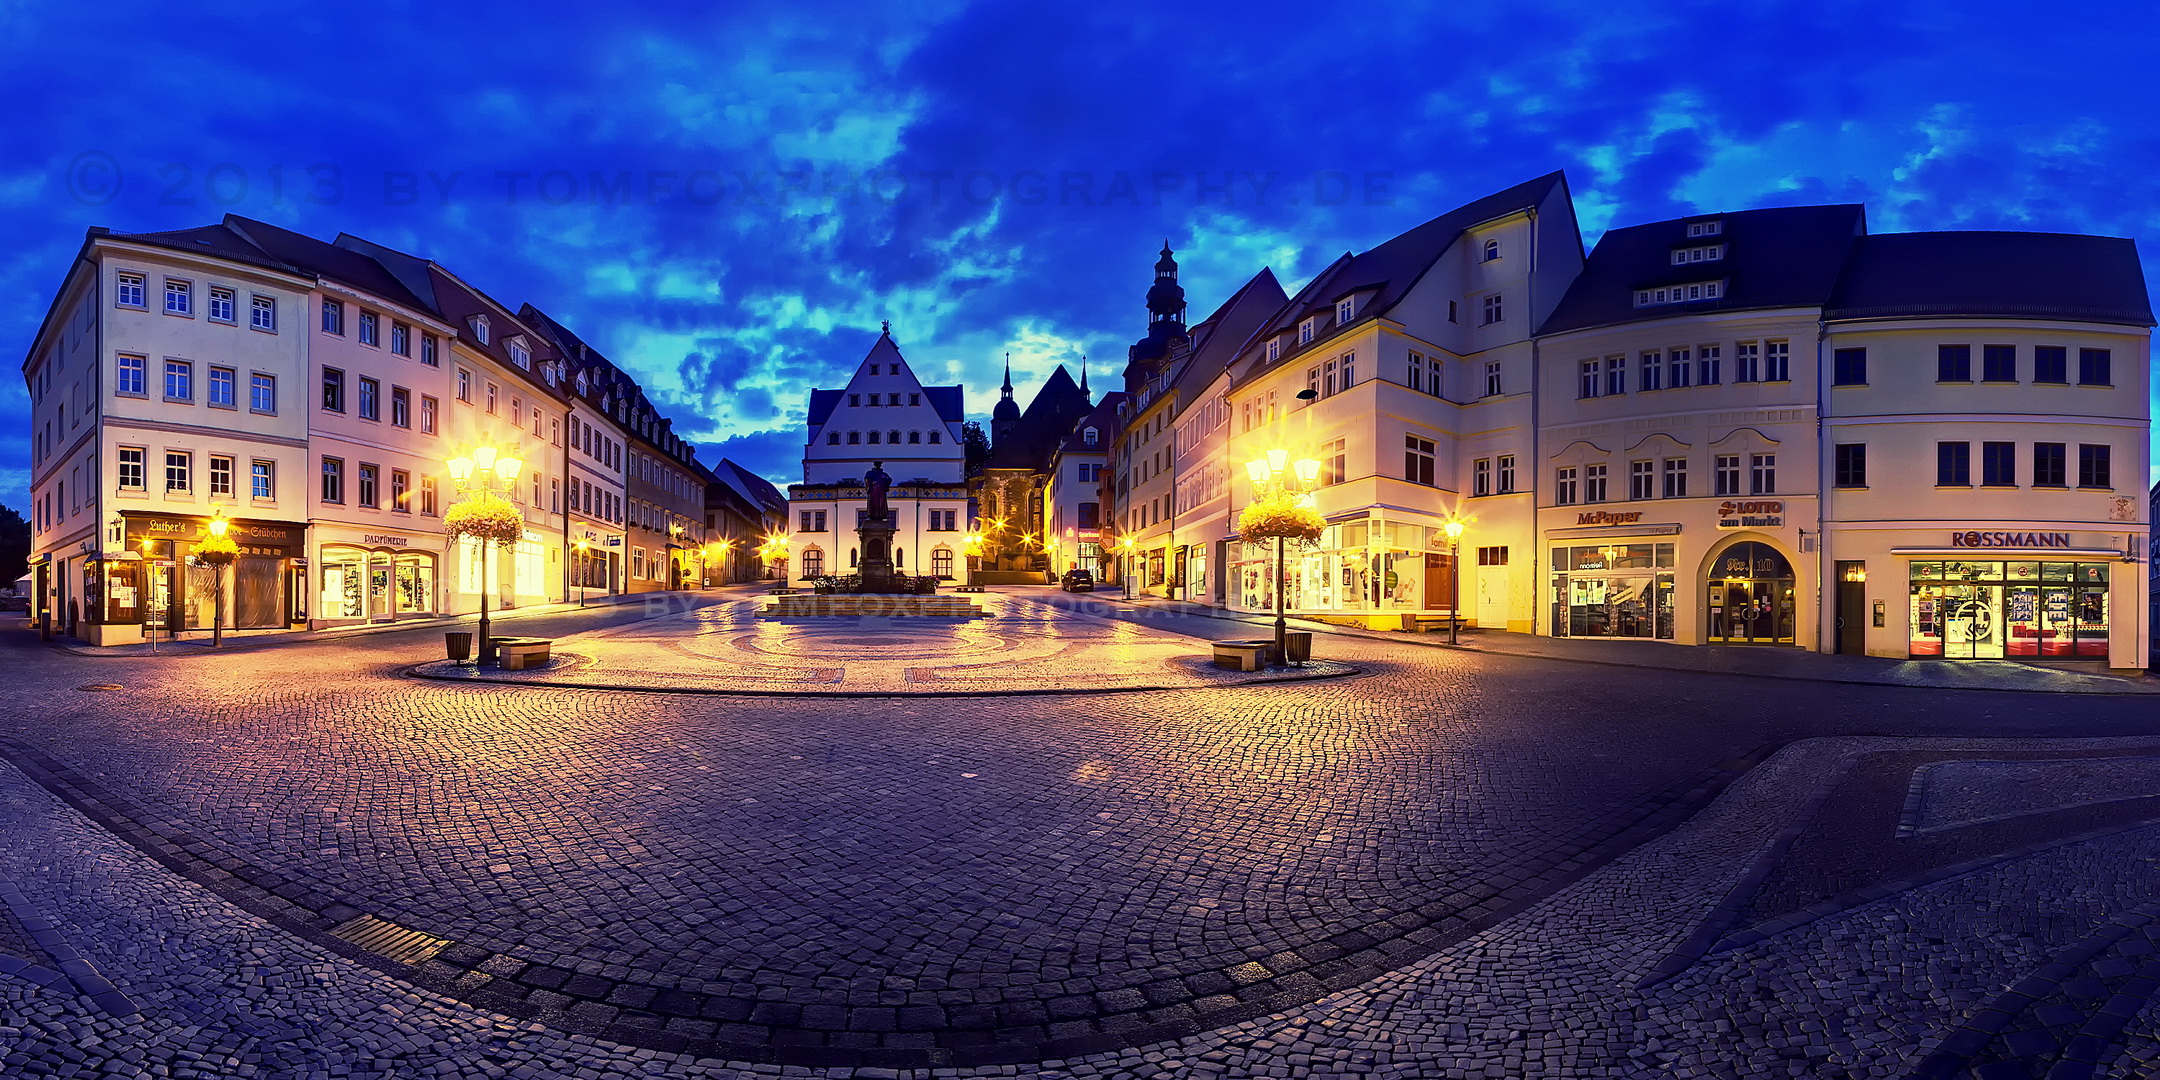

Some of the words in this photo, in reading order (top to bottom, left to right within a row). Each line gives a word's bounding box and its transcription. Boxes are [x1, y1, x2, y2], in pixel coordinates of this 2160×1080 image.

[1737, 502, 1783, 514] LOTTO
[1577, 511, 1642, 526] McPaper
[1719, 519, 1739, 527] am
[1741, 515, 1781, 527] Markt
[149, 519, 186, 534] Luther's
[364, 534, 408, 547] PARFÜMERIE
[1952, 531, 2070, 548] ROSSMANN
[1756, 558, 1774, 571] 10
